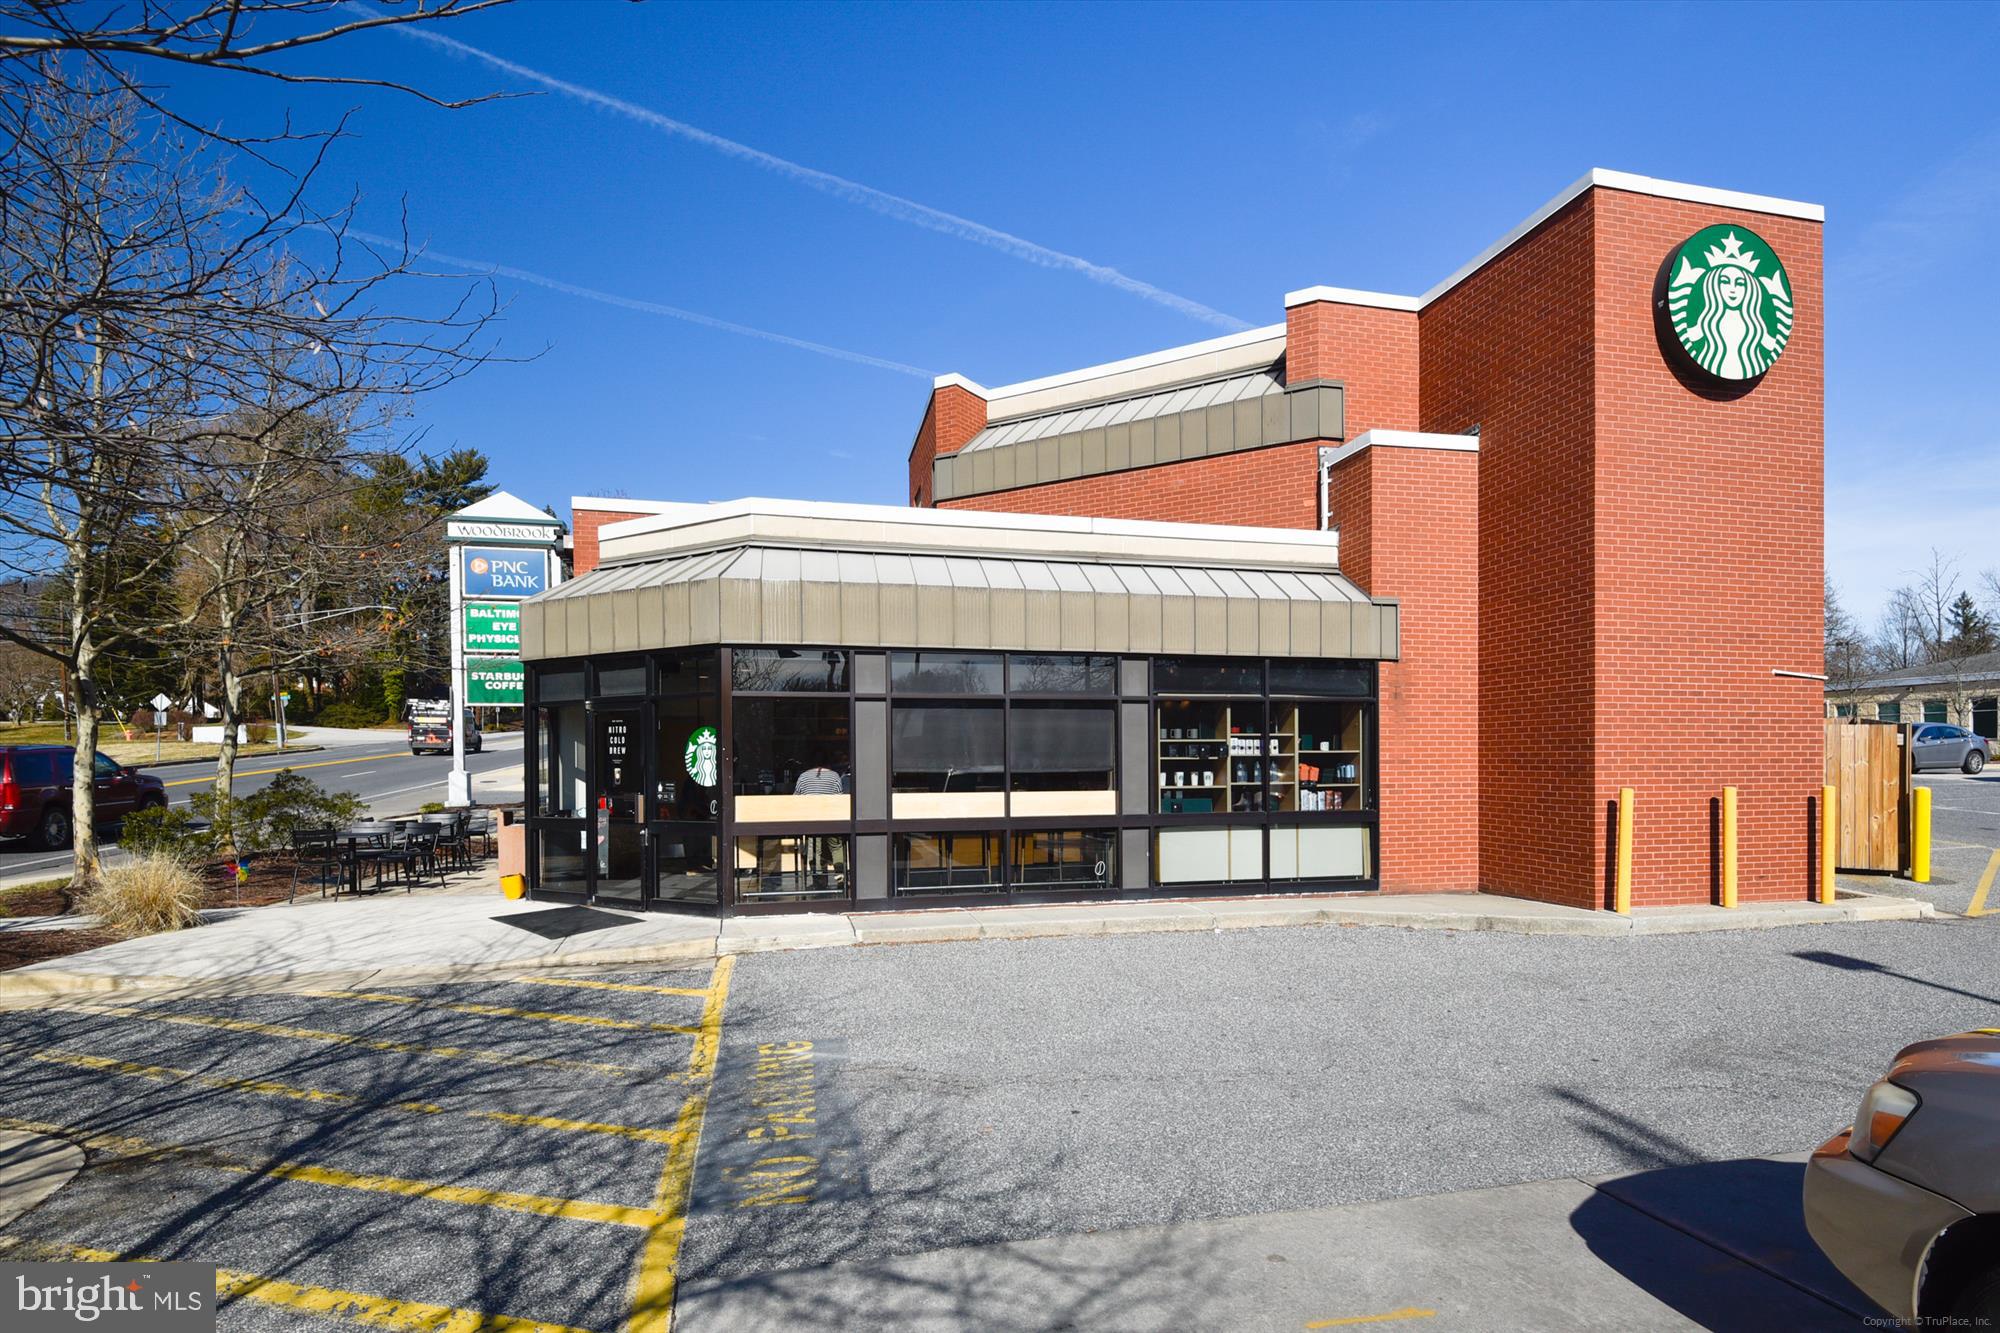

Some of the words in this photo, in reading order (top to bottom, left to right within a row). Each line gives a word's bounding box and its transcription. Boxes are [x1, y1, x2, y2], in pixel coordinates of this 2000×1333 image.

[490, 560, 529, 574] PNC
[490, 574, 540, 589] BANK
[492, 622, 517, 631] EYE
[608, 726, 627, 734] NITRO
[609, 736, 626, 744] COLD
[609, 747, 627, 755] BREW
